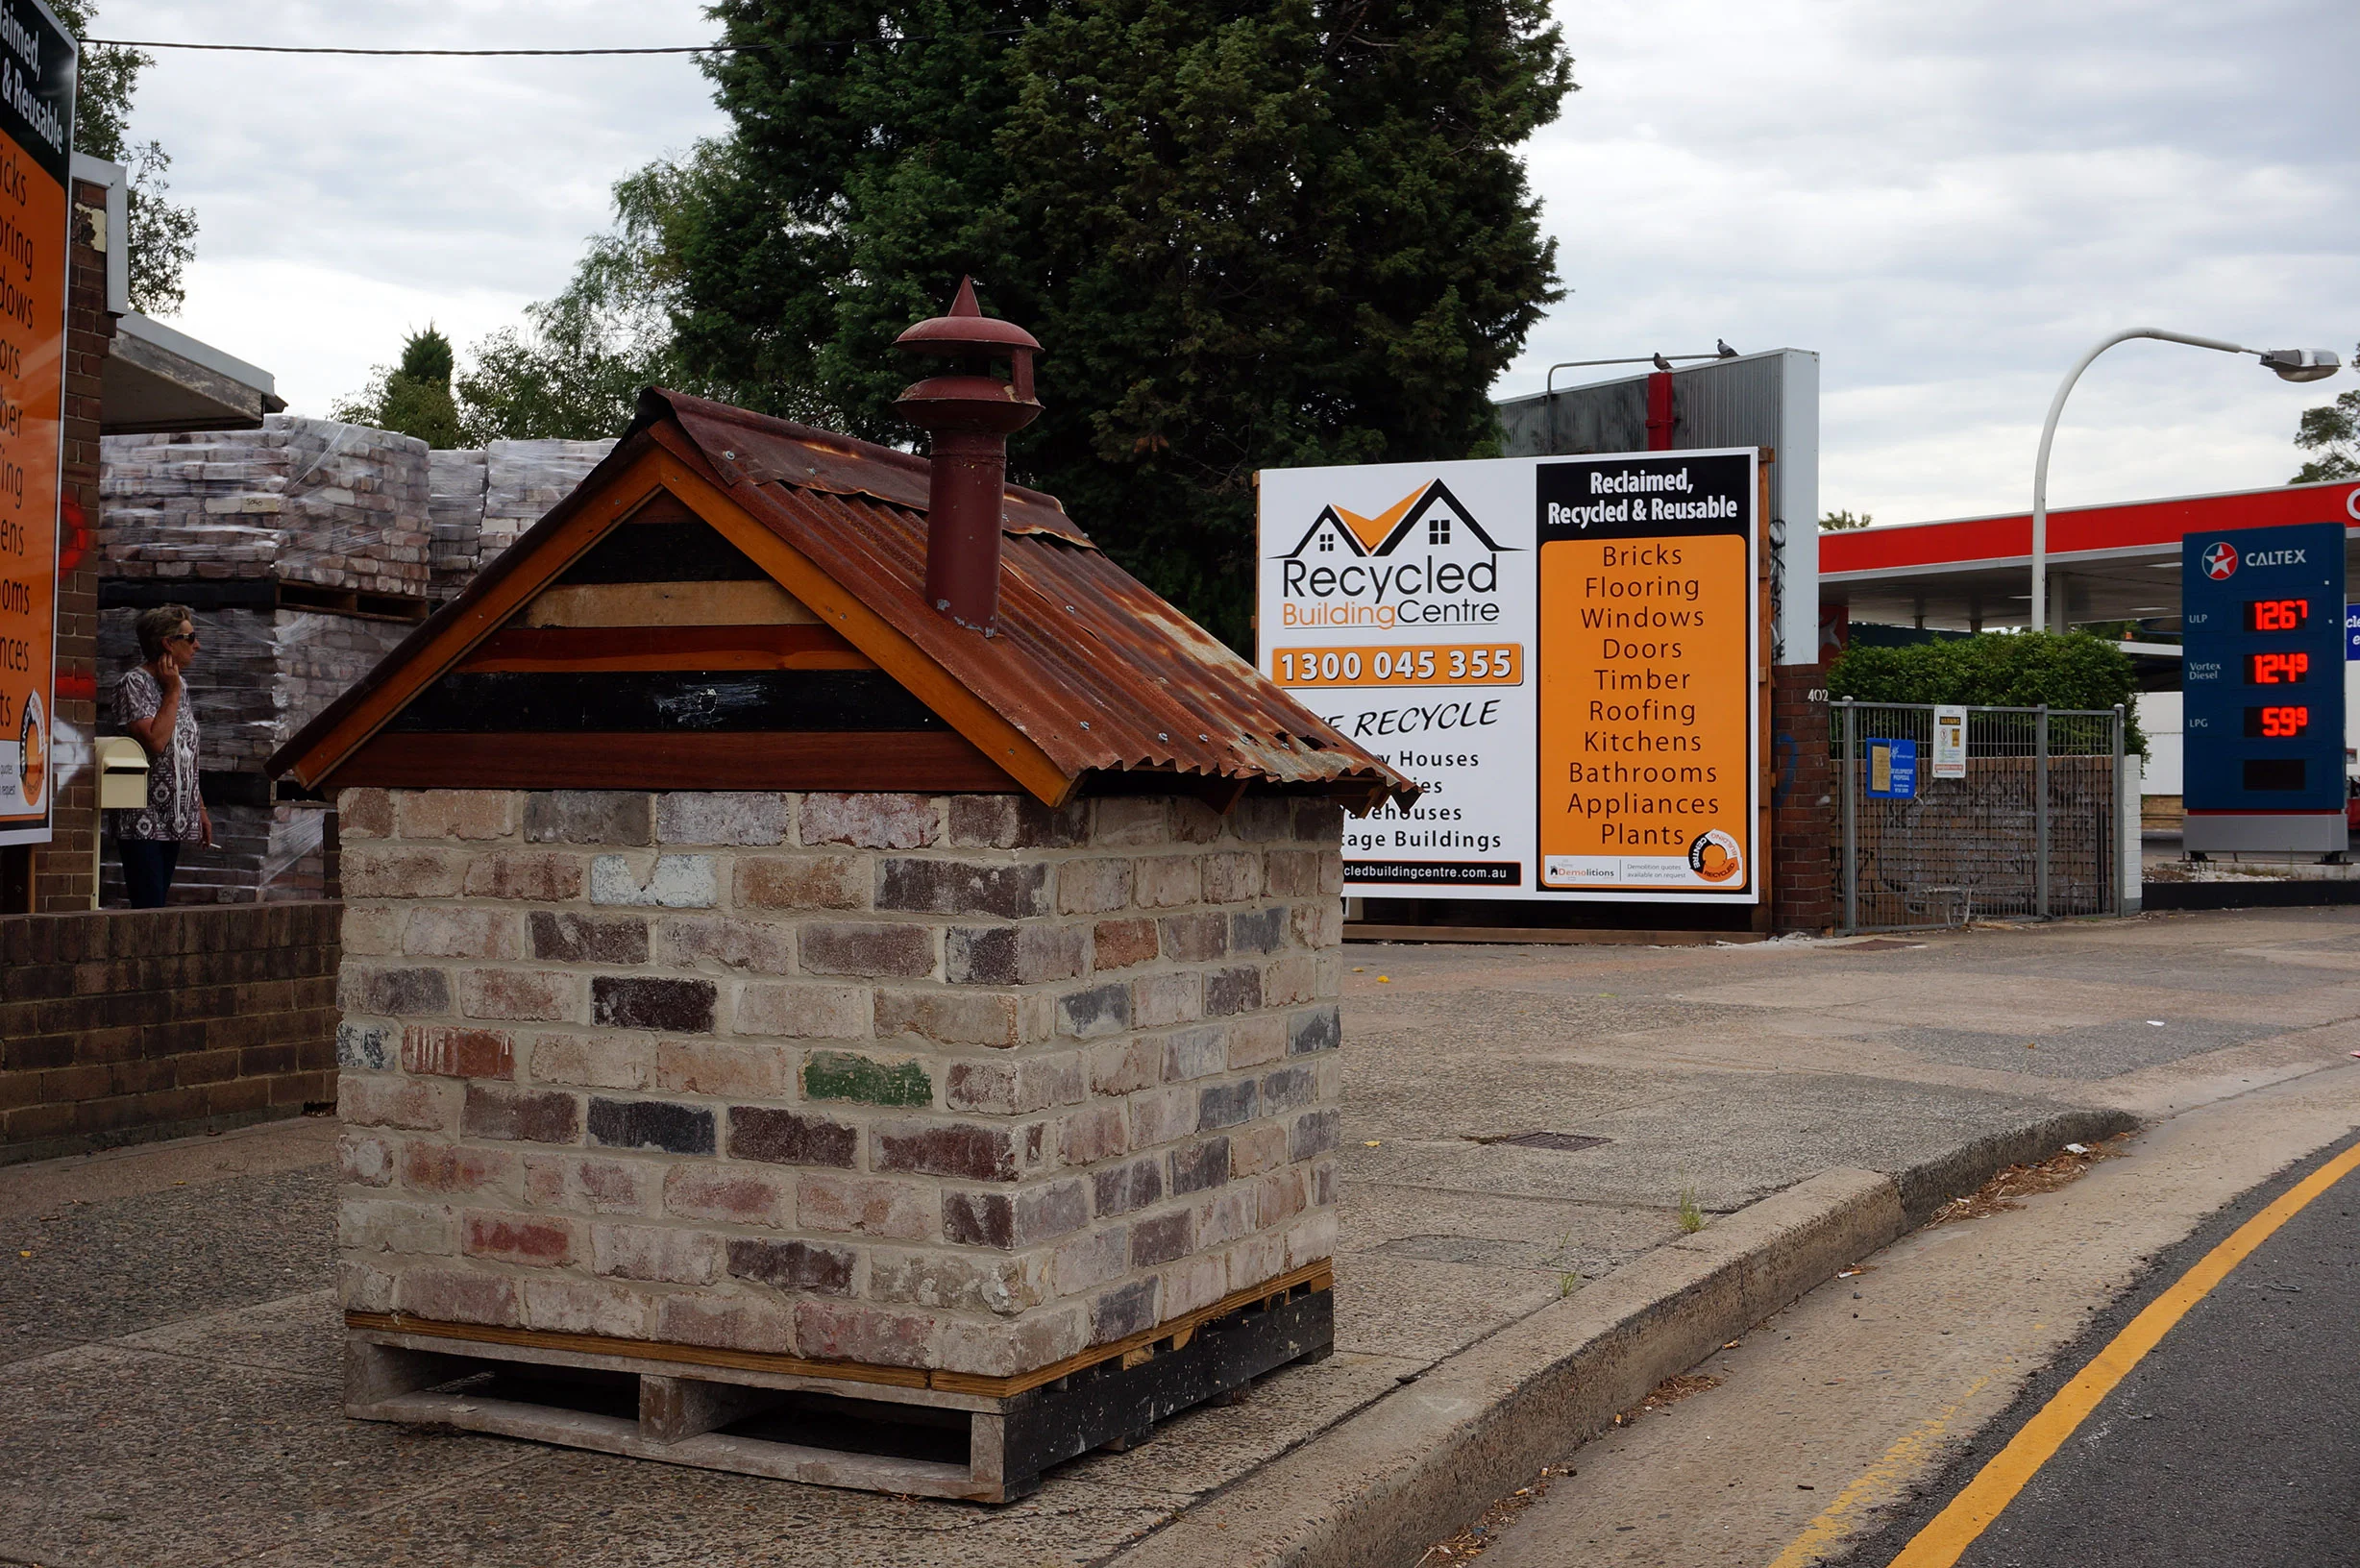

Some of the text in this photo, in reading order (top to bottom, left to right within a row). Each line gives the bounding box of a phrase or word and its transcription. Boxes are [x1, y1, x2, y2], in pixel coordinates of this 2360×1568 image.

[2, 58, 63, 155] & Reusable
[0, 443, 23, 509] ing
[1590, 467, 1694, 494] Reclaimed,
[1548, 495, 1737, 529] Recycled & Reusable
[1603, 544, 1683, 567] Bricks
[2245, 549, 2307, 567] CALTEX
[1284, 552, 1497, 604] Recycled
[1586, 576, 1699, 600] Flooring
[1581, 606, 1704, 628] Windows
[2189, 614, 2208, 624] ULP
[1603, 638, 1683, 659] Doors
[1281, 649, 1512, 680] 1300 045 355
[2189, 662, 2222, 671] Vortex
[2189, 671, 2218, 680] Diesel
[1594, 669, 1690, 690] Timber
[1807, 688, 1829, 702] 402
[1353, 698, 1501, 737] RECYCLE
[1590, 698, 1695, 725] Roofing
[2189, 719, 2208, 728] LPG
[1585, 730, 1702, 752] Kitchens
[1399, 750, 1480, 767] Houses
[1570, 761, 1717, 783] Bathrooms
[1567, 792, 1719, 819] Appliances
[1394, 830, 1501, 852] Buildings
[1602, 822, 1684, 845] Plants
[1692, 837, 1708, 870] CENTRE
[1559, 868, 1614, 877] Demolitions
